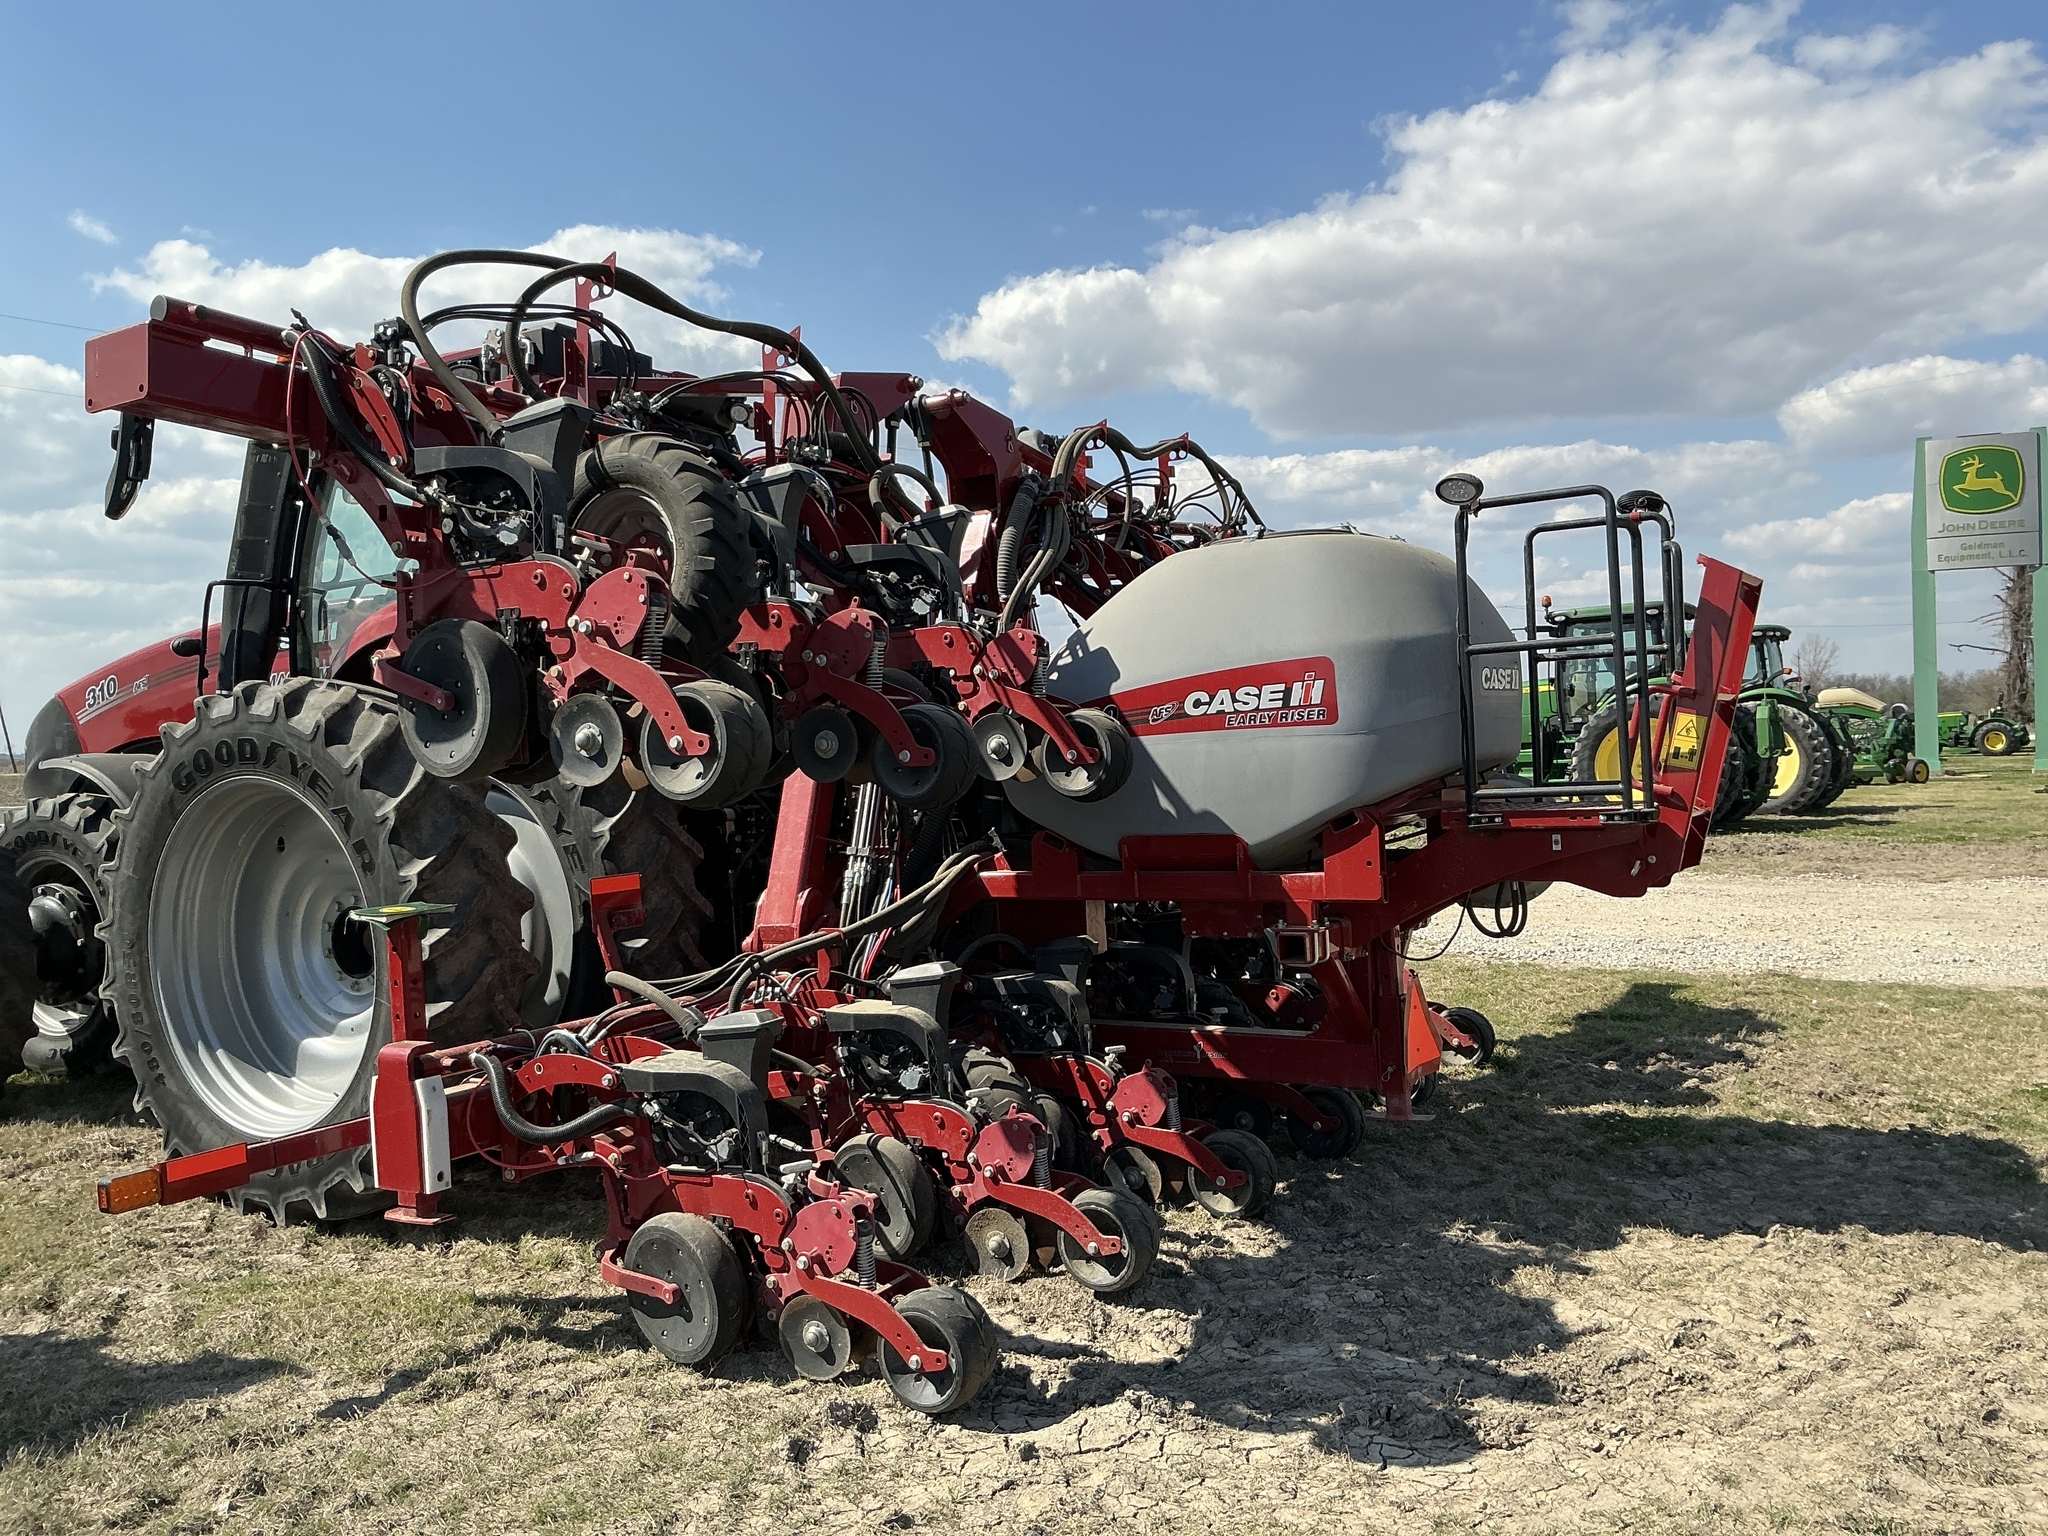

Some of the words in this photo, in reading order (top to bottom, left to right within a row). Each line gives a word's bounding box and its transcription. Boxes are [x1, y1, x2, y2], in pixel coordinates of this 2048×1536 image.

[1937, 522, 1976, 534] JOHN
[1978, 518, 2026, 530] DEERE
[1937, 551, 1995, 563] Equipment,
[1999, 549, 2029, 559] L.L.C.
[1481, 666, 1511, 690] CASE
[85, 675, 118, 709] 310
[1148, 704, 1174, 721] AFS
[1183, 683, 1286, 716] CASE
[1225, 710, 1276, 728] EARLY
[1278, 708, 1327, 724] RISER
